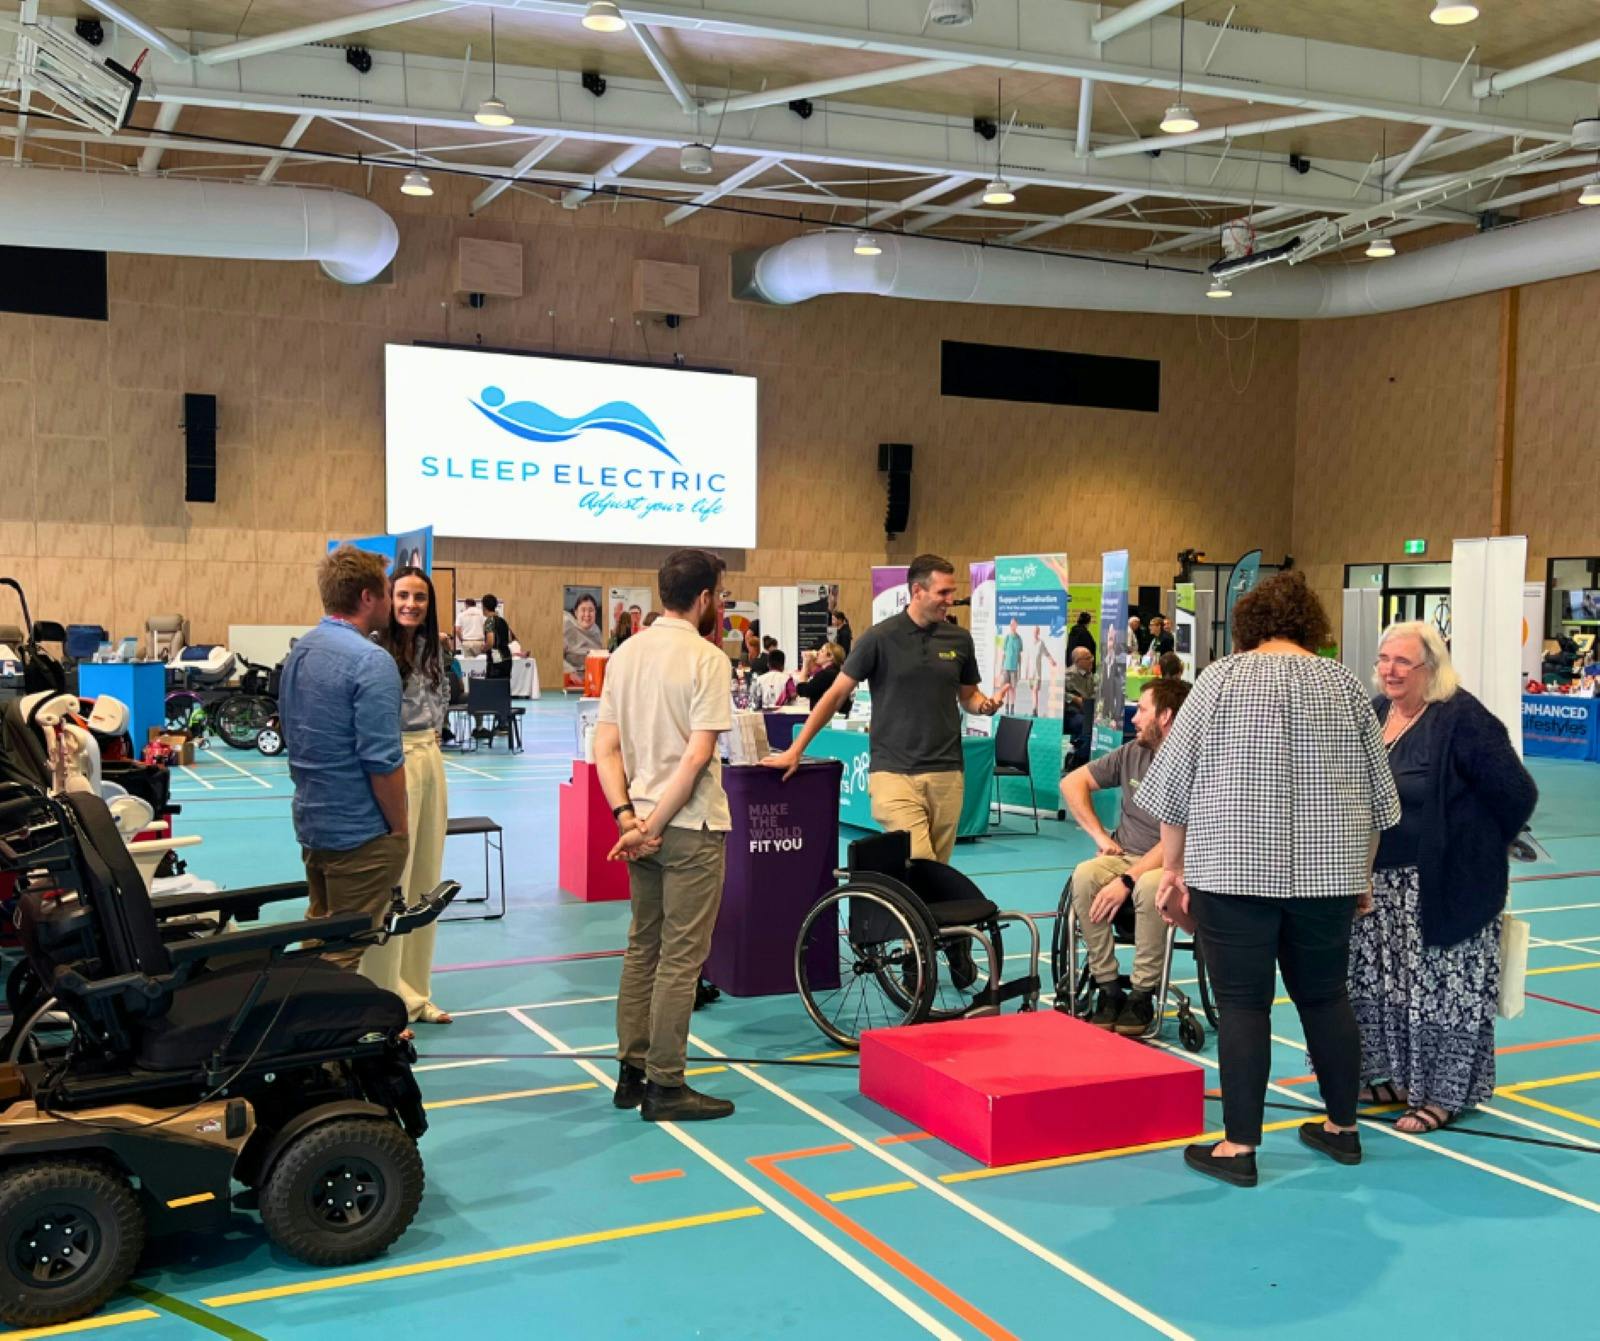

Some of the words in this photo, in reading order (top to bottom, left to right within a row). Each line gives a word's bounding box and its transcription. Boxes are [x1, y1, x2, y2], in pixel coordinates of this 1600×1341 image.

[421, 456, 540, 482] SLEEP
[554, 464, 726, 493] ELECTRIC
[578, 491, 646, 517] Adjust
[637, 501, 685, 519] your
[691, 497, 725, 522] life
[748, 803, 789, 816] MAKE
[750, 816, 778, 828] THE
[750, 826, 802, 840] WORLD
[750, 839, 771, 853] FIT
[774, 837, 802, 852] YOU
